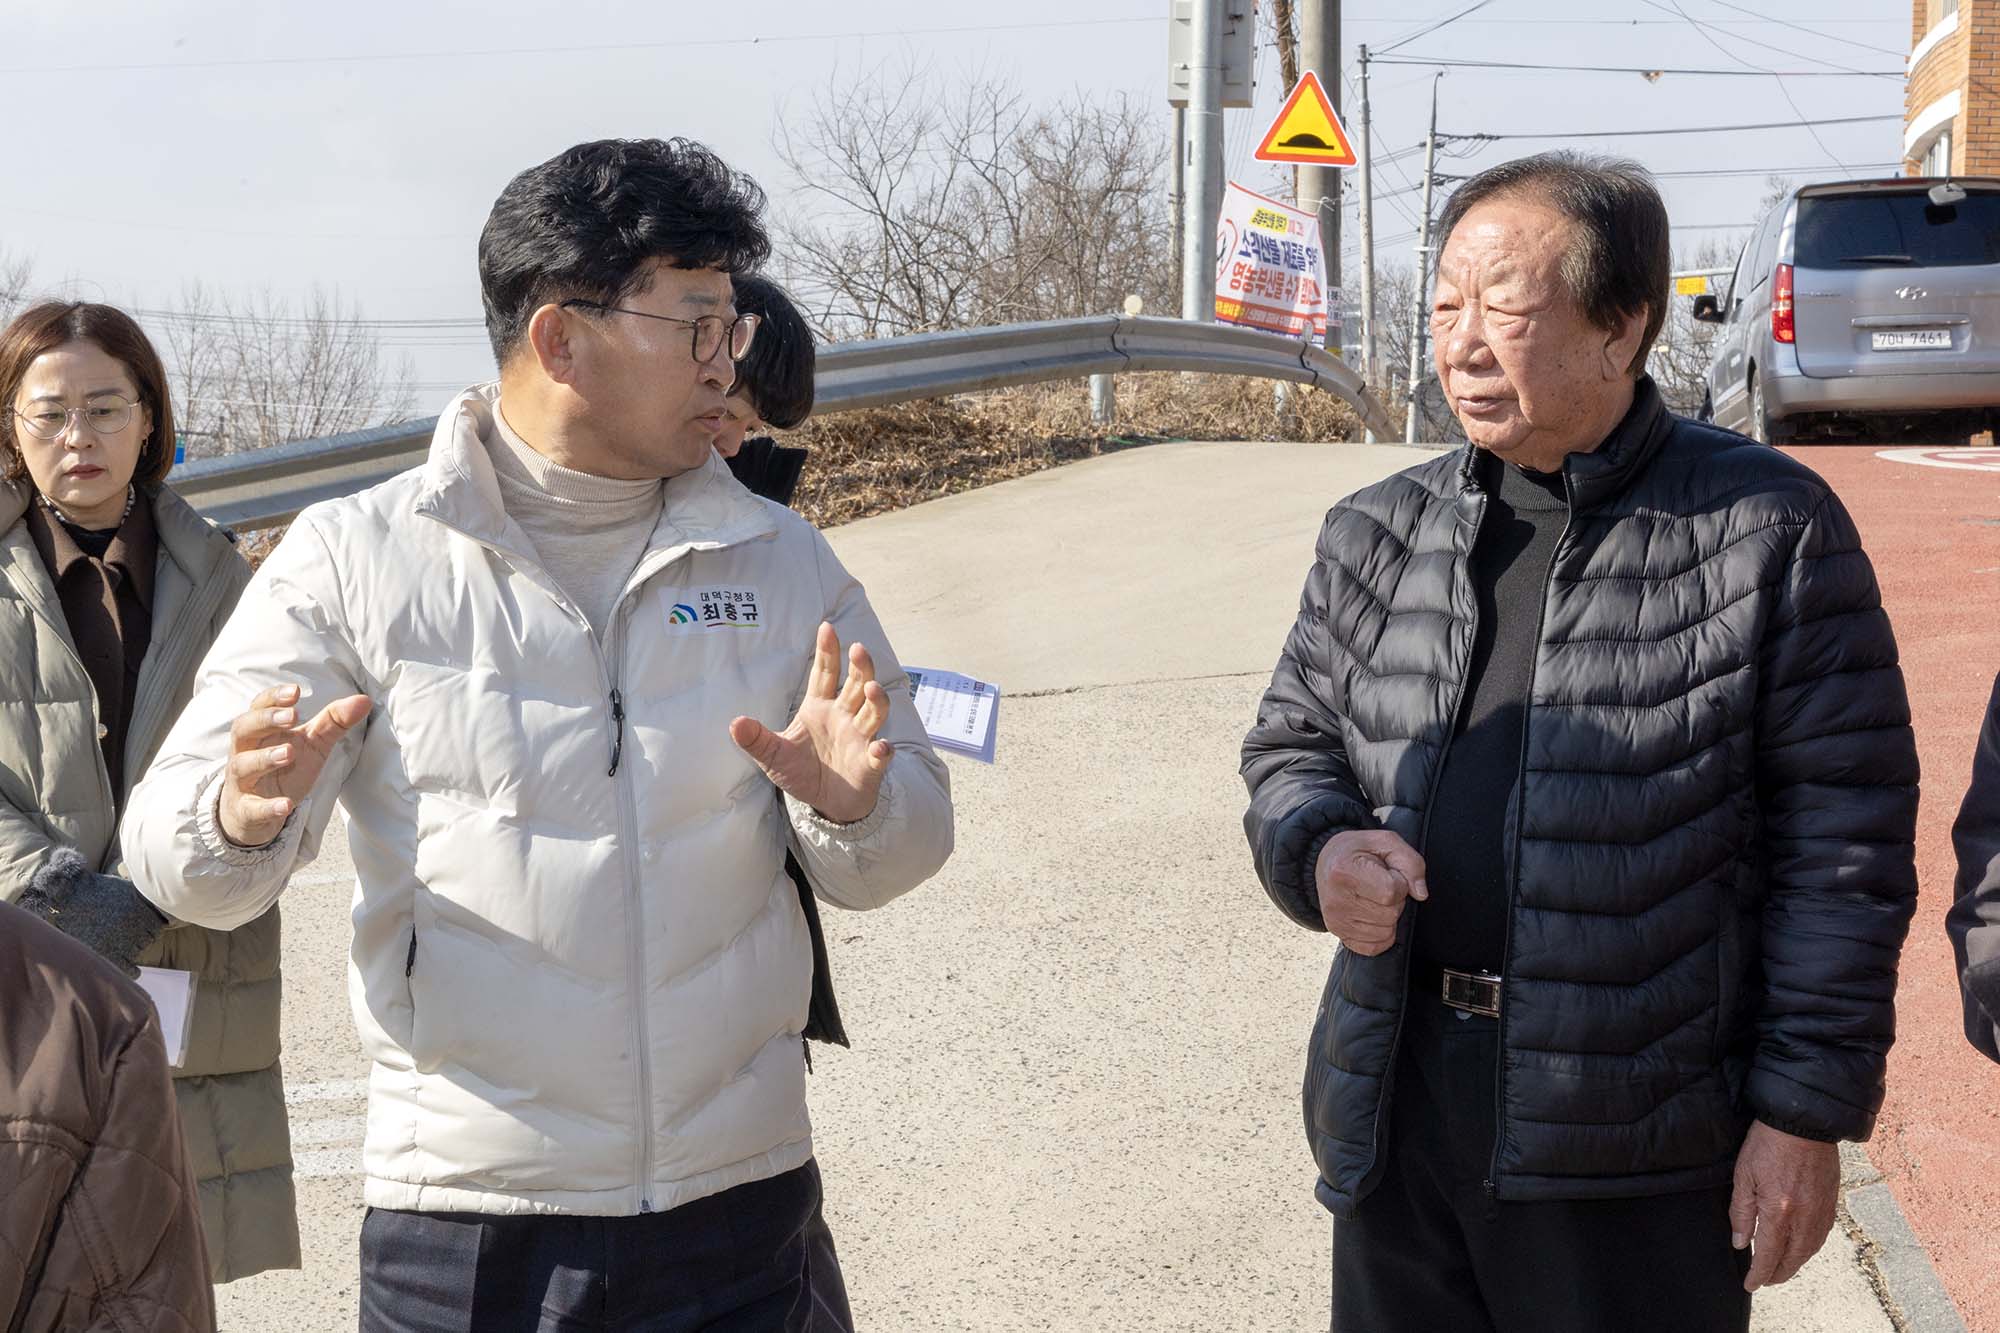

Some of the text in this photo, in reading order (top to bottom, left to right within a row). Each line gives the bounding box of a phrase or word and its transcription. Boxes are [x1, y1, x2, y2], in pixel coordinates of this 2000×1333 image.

[1230, 261, 1284, 300] 영농부산물
[1910, 332, 1943, 345] 7461
[700, 590, 754, 602] 대덕구청장
[703, 602, 758, 621] 최충규
